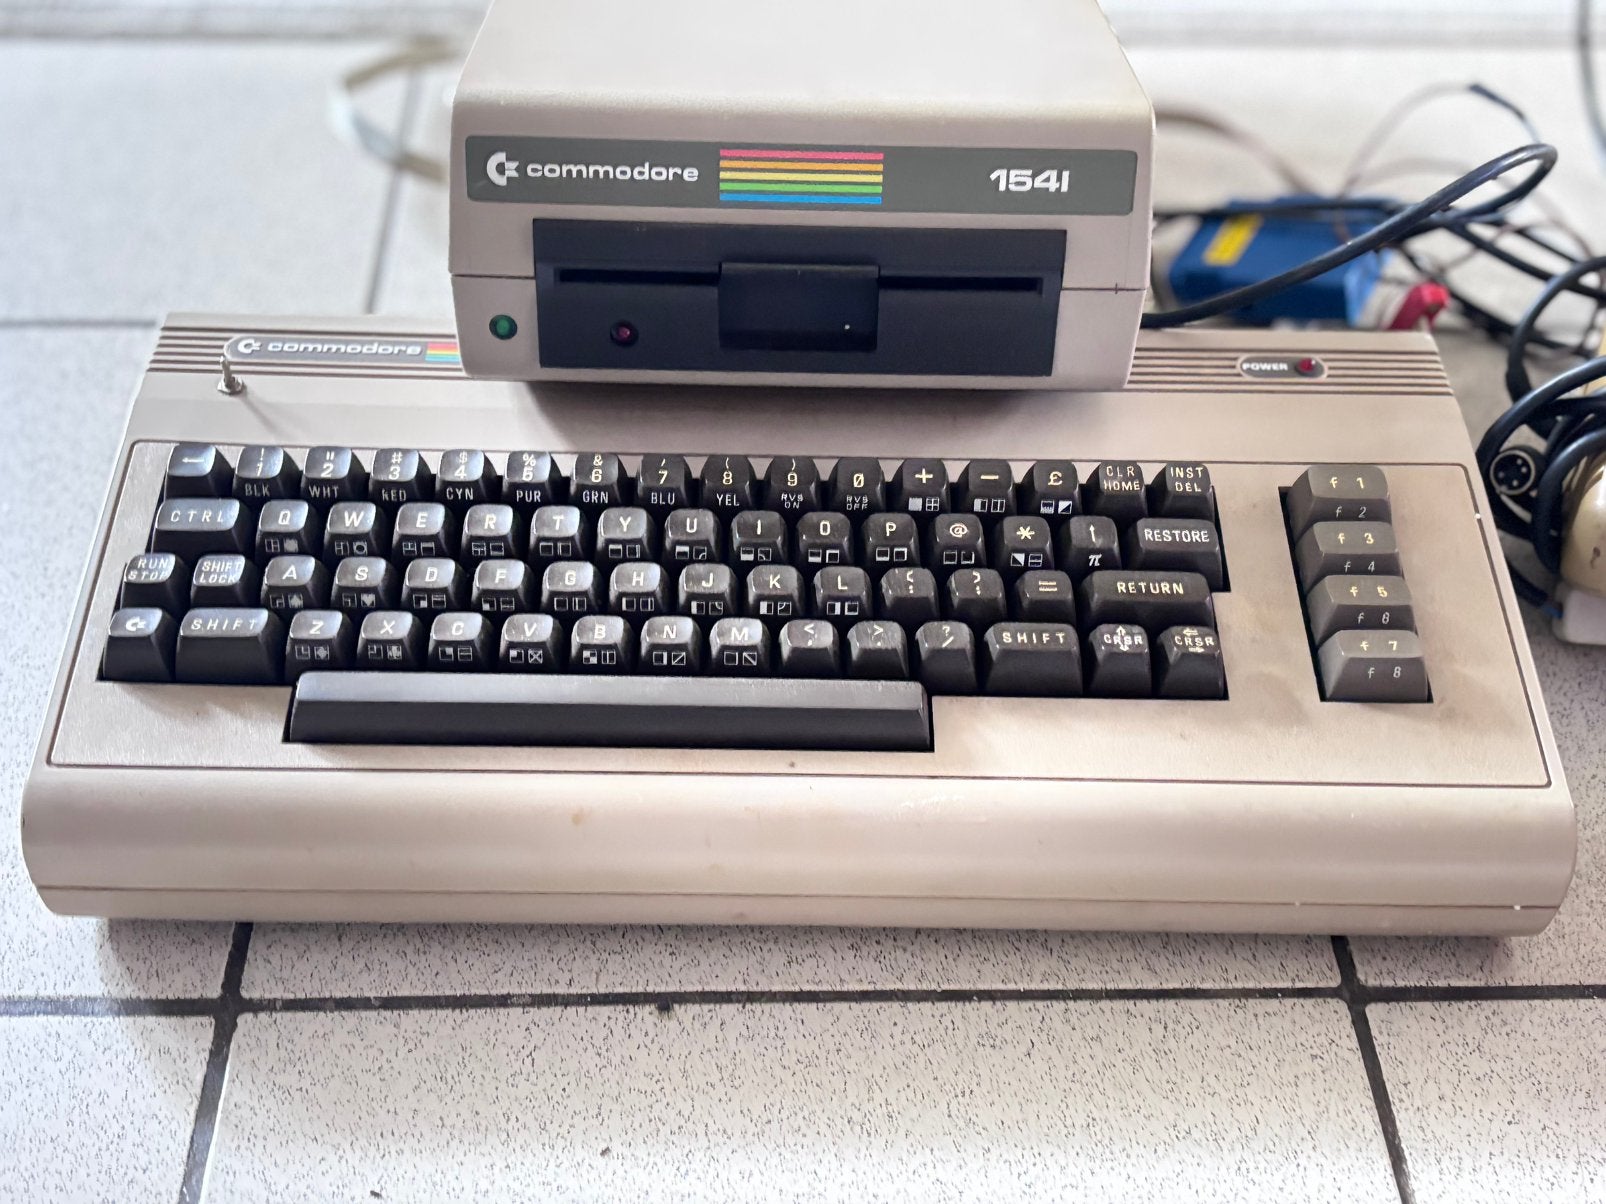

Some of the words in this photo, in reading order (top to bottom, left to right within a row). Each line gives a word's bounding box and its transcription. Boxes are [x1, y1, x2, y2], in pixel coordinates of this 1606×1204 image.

[527, 162, 698, 181] commodore
[989, 169, 1070, 192] 1541
[268, 341, 421, 355] commodore
[1242, 363, 1288, 371] POWER
[391, 452, 402, 464] #
[459, 451, 468, 463] $
[523, 453, 536, 466] %
[593, 455, 603, 466] &
[321, 463, 333, 477] 2
[388, 466, 400, 480] 3
[455, 466, 466, 479] 4
[523, 468, 533, 481] 5
[591, 469, 602, 482] 6
[915, 468, 933, 483] +
[1106, 466, 1135, 477] CLR
[1170, 467, 1203, 478] INST
[658, 470, 668, 484] 7
[722, 471, 733, 485] 8
[787, 472, 798, 486] 9
[1048, 472, 1063, 485] £
[245, 485, 270, 497] BLK
[309, 485, 338, 498] WHT
[1103, 480, 1140, 491] HOME
[1175, 482, 1201, 492] DEL
[382, 489, 407, 501] RED
[446, 488, 474, 500] CYN
[516, 490, 541, 502] PUR
[583, 491, 608, 504] GRN
[651, 492, 676, 505] BLU
[716, 493, 740, 507] YEL
[171, 511, 223, 523] CTRL
[279, 511, 290, 525] Q
[344, 511, 364, 527] W
[416, 512, 428, 527] E
[484, 514, 496, 529] R
[553, 515, 564, 530] T
[619, 516, 631, 532] Y
[686, 518, 698, 533] U
[757, 520, 762, 535] I
[886, 521, 896, 536] P
[949, 523, 968, 537] @
[1144, 529, 1210, 542] RESTORE
[138, 559, 168, 569] RUN
[202, 561, 241, 572] SHIFT
[1088, 554, 1102, 566] π
[128, 571, 167, 581] STOP
[200, 572, 235, 584] LOCK
[283, 566, 297, 580] A
[355, 567, 368, 581] S
[425, 567, 438, 581] D
[495, 569, 507, 583] F
[565, 570, 576, 585] G
[632, 571, 644, 586] H
[702, 573, 714, 587] J
[769, 574, 781, 589] K
[838, 575, 848, 590] L
[1039, 580, 1058, 591] =
[1117, 582, 1184, 594] RETURN
[191, 619, 256, 630] SHIFT
[310, 620, 324, 634] Z
[380, 620, 395, 634] X
[451, 622, 464, 635] C
[524, 623, 537, 636] V
[804, 623, 814, 634] <
[873, 625, 884, 635] >
[594, 624, 606, 639] B
[663, 625, 677, 639] N
[731, 627, 749, 641] M
[1002, 632, 1065, 643] SHIFT
[1103, 634, 1143, 645] CRSR
[1174, 636, 1214, 646] CRSR
